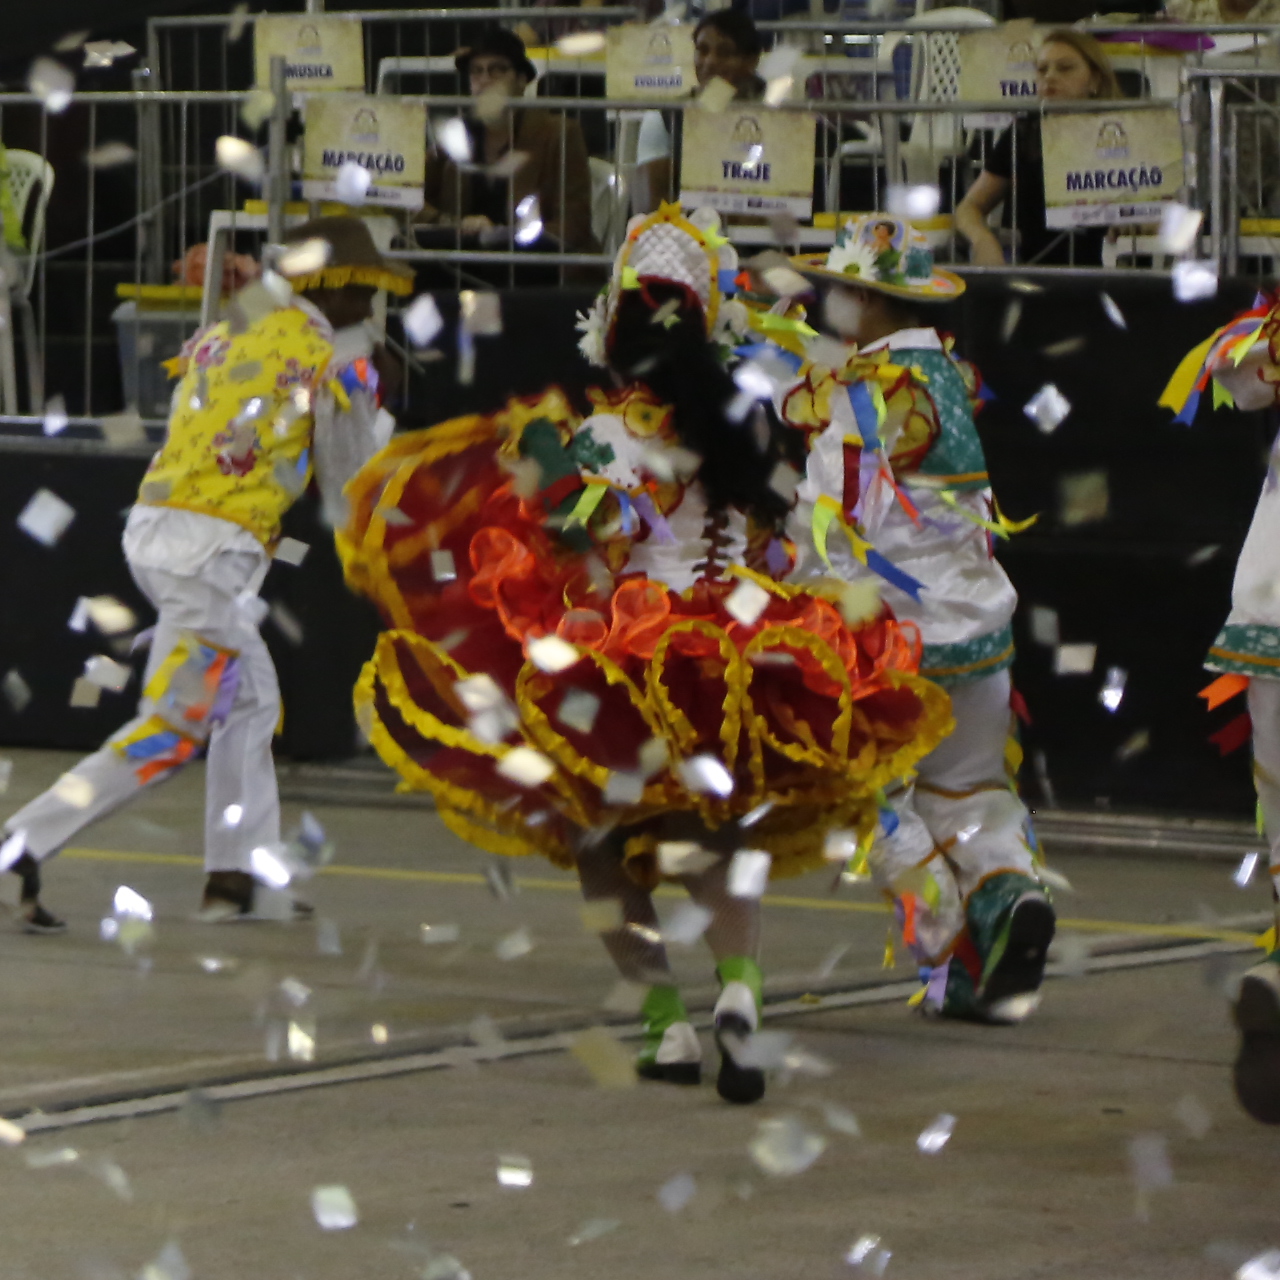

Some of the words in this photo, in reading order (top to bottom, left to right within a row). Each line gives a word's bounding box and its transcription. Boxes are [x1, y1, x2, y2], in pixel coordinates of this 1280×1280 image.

[999, 80, 1037, 96] TRAJ
[721, 160, 771, 182] TRAJE
[1066, 163, 1163, 192] MARCAÇÃO
